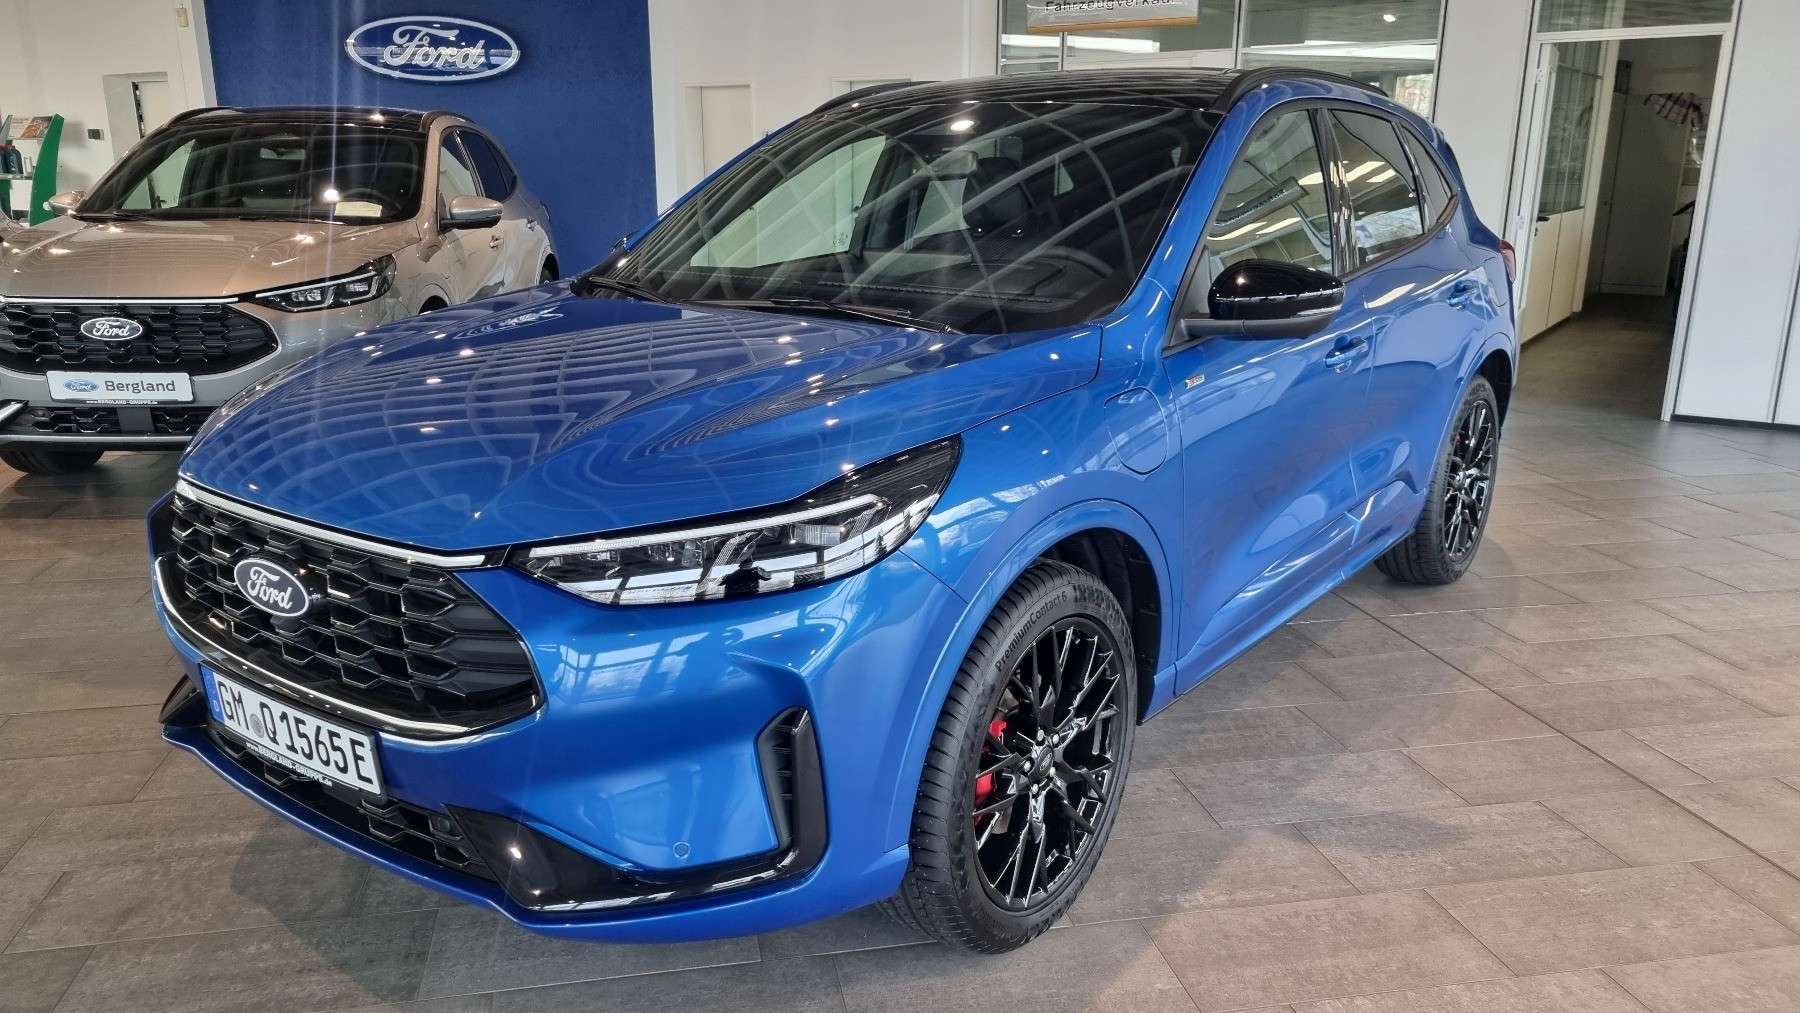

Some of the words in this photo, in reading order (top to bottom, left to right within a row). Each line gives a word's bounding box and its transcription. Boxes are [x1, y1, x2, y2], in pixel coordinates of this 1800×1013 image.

[383, 25, 485, 70] Ford
[93, 320, 130, 337] Ford
[104, 380, 176, 394] Bergland
[246, 566, 293, 609] Ford
[993, 594, 1061, 673] PremiumContact
[218, 682, 249, 731] GM
